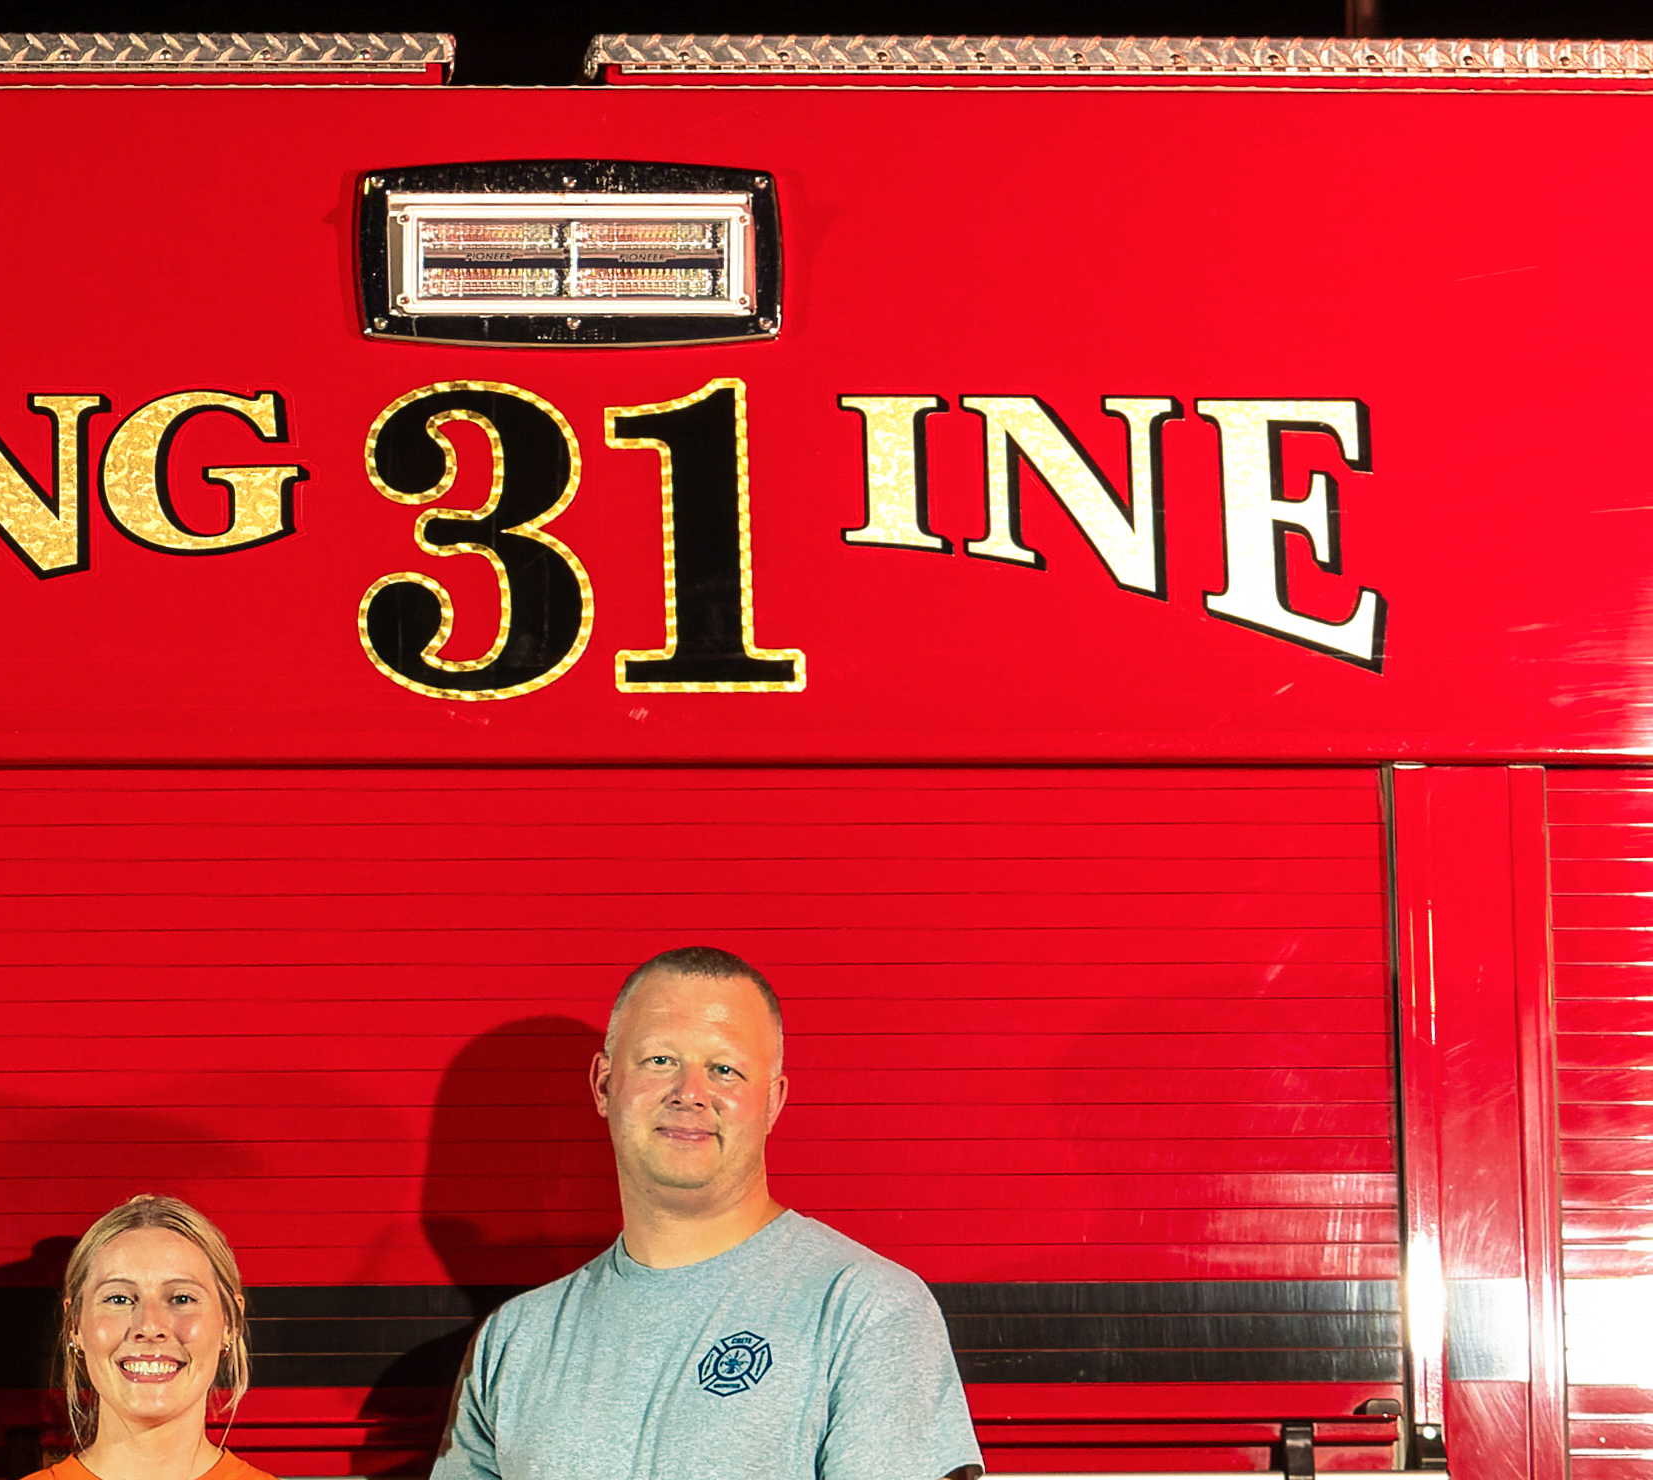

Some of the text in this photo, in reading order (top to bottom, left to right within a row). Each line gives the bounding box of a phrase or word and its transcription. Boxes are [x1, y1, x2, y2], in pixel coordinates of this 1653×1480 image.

[466, 252, 512, 260] PIONEER
[619, 253, 665, 261] PIONEER
[358, 376, 806, 699] 31
[838, 393, 1386, 671] INE
